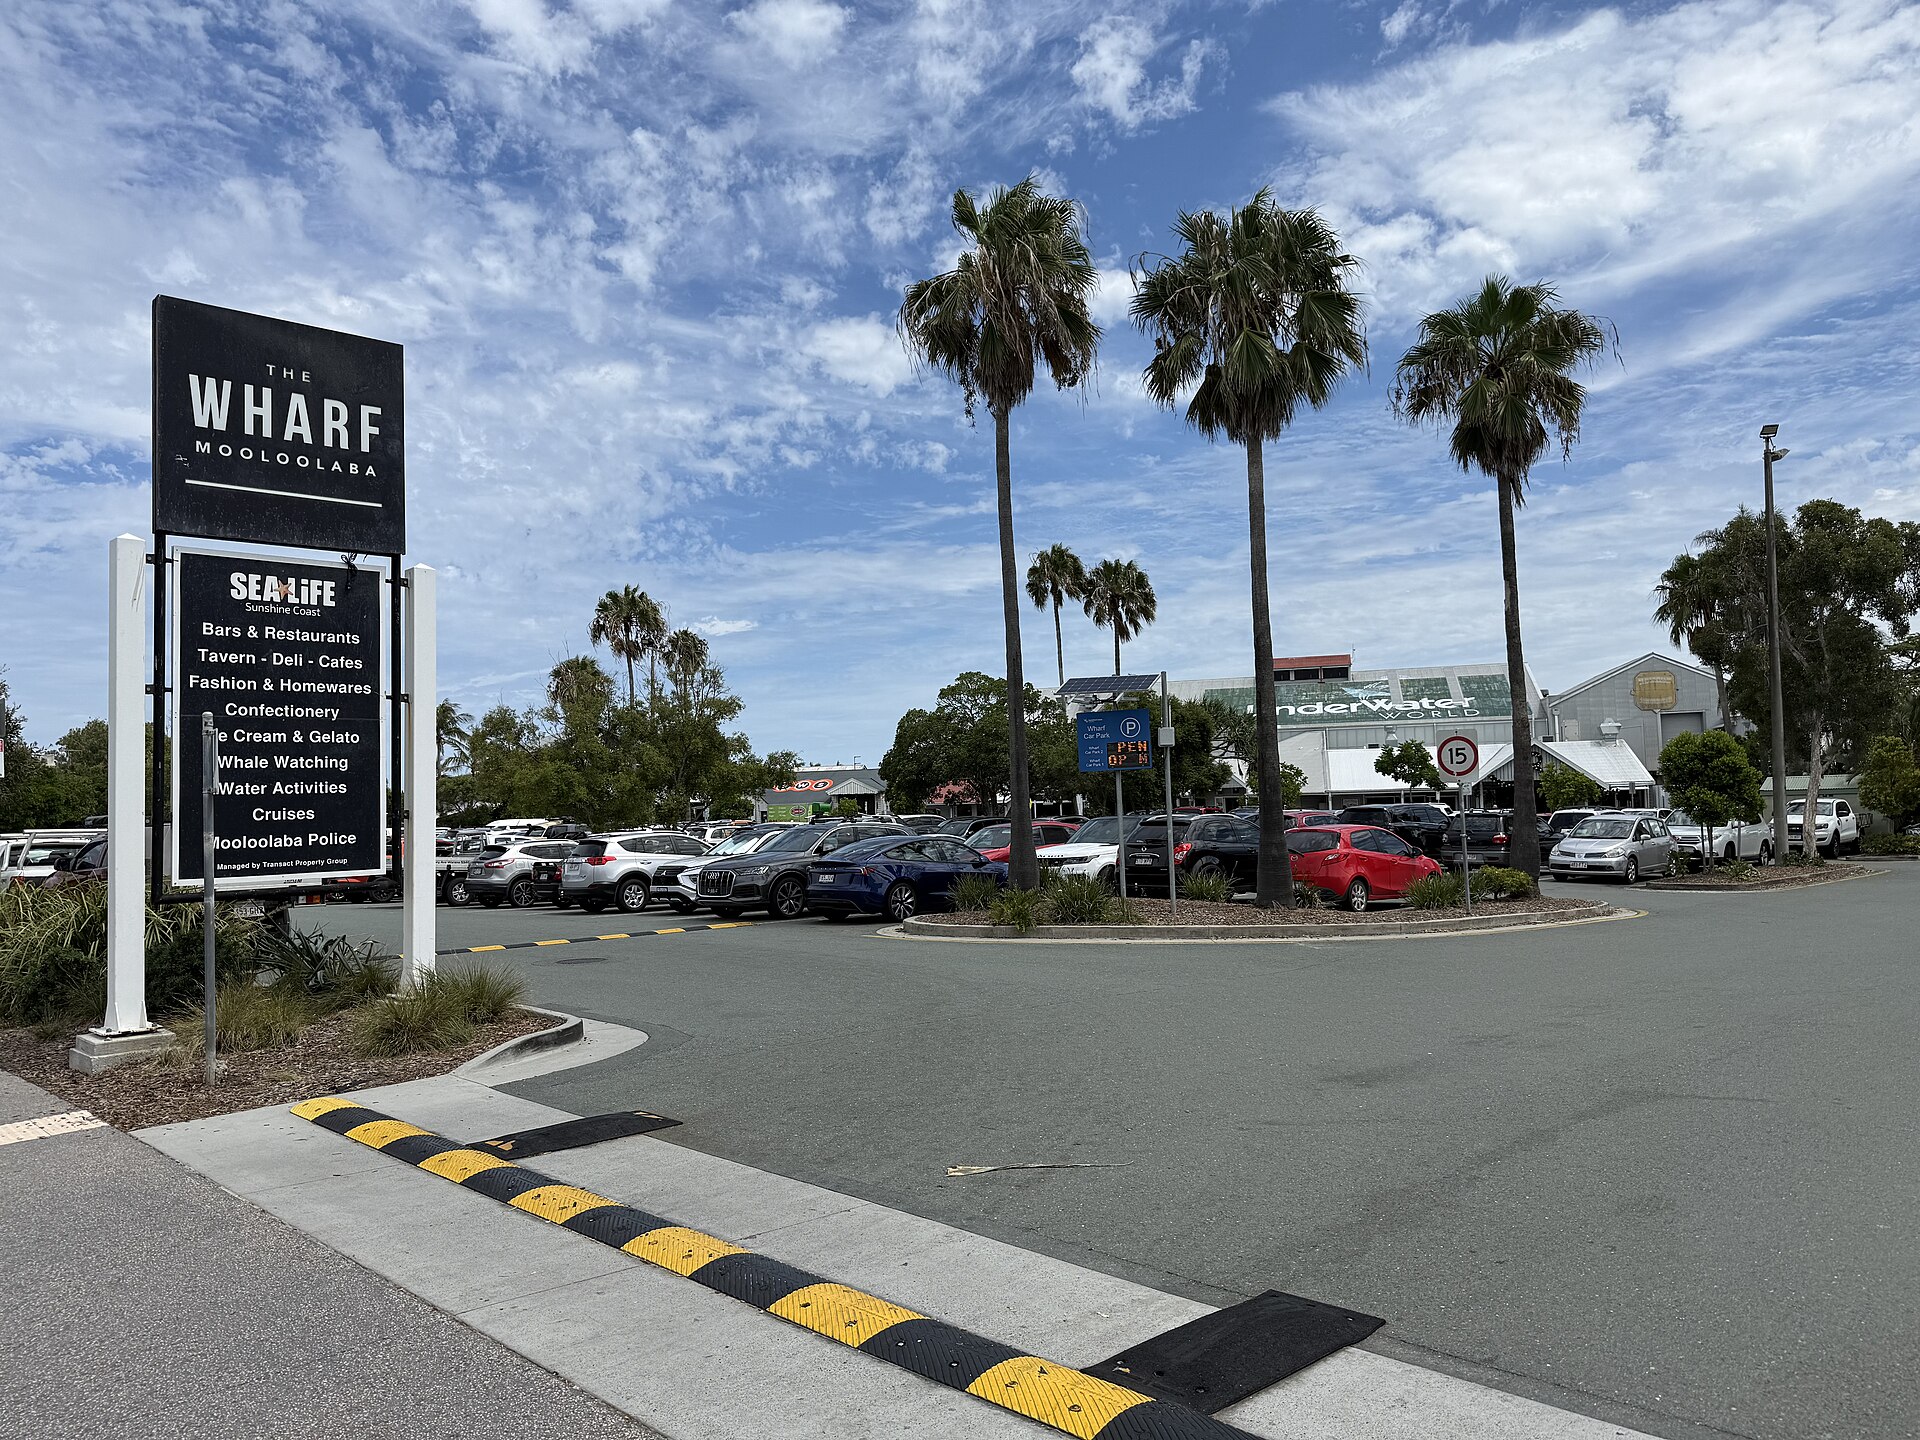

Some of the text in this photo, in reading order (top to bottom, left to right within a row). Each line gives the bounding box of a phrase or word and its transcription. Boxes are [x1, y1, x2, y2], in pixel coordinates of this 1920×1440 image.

[266, 364, 311, 383] THE
[188, 373, 382, 453] WHARF
[195, 440, 377, 477] MOOLOOLABA
[230, 572, 281, 603] SEA
[245, 602, 321, 617] Sunshine Coast
[202, 621, 360, 645] Bars & Restaurants
[197, 648, 256, 665] Tavern
[272, 652, 303, 667] Deli
[318, 654, 363, 670] Cafes
[189, 674, 372, 695] Fashion & Homewares
[225, 702, 340, 721] Confectionery
[1379, 709, 1480, 719] WORLD
[233, 728, 287, 743] Cream
[292, 729, 304, 743] &
[309, 730, 360, 744] Gelato
[1126, 721, 1136, 734] P
[218, 755, 349, 772] Whale Watching
[1448, 747, 1468, 765] 15
[218, 780, 347, 796] Water Activities
[252, 807, 315, 822] Cruises
[308, 832, 357, 846] Police
[216, 857, 348, 871] Managed by Transact Property Group
